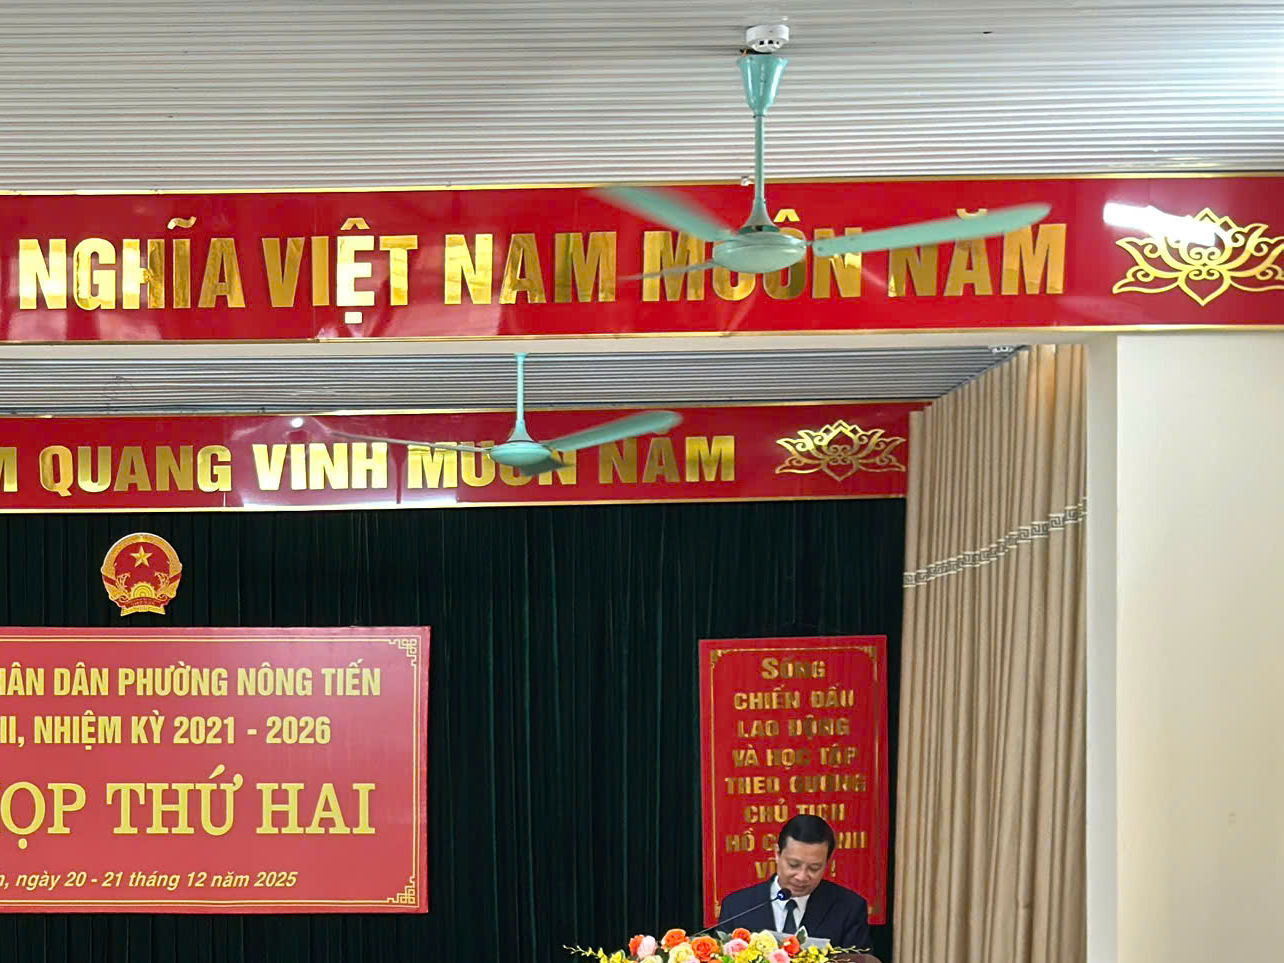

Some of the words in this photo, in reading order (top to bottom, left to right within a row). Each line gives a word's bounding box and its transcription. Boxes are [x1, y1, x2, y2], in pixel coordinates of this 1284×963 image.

[19, 216, 246, 312] NGHĨA
[263, 217, 418, 324] VIỆT
[444, 232, 616, 306] NAM
[887, 208, 1067, 298] NĂM
[38, 445, 233, 497] QUANG
[252, 442, 389, 491] VINH
[598, 430, 736, 484] NĂM
[53, 661, 109, 697] DÂN
[118, 660, 228, 697] PHƯỜNG
[237, 662, 313, 696] NÔNG
[321, 658, 381, 696] TIẾN
[733, 683, 801, 711] CHIẾN
[33, 709, 122, 751] NHIỆM
[130, 709, 165, 744] KỲ
[173, 715, 236, 745] 2021
[266, 715, 332, 745] 2026
[738, 719, 780, 739] LAO
[731, 743, 760, 768] VÀ
[724, 776, 780, 795] THEO
[105, 764, 243, 836] THỨ
[256, 783, 377, 836] HAI
[745, 797, 789, 823] CHỦ
[15, 872, 61, 890] ngày
[64, 872, 87, 887] 20
[101, 872, 124, 887] 21
[127, 871, 181, 890] tháng
[186, 872, 207, 887] 12
[211, 872, 250, 887] năm
[254, 872, 298, 887] 2025
